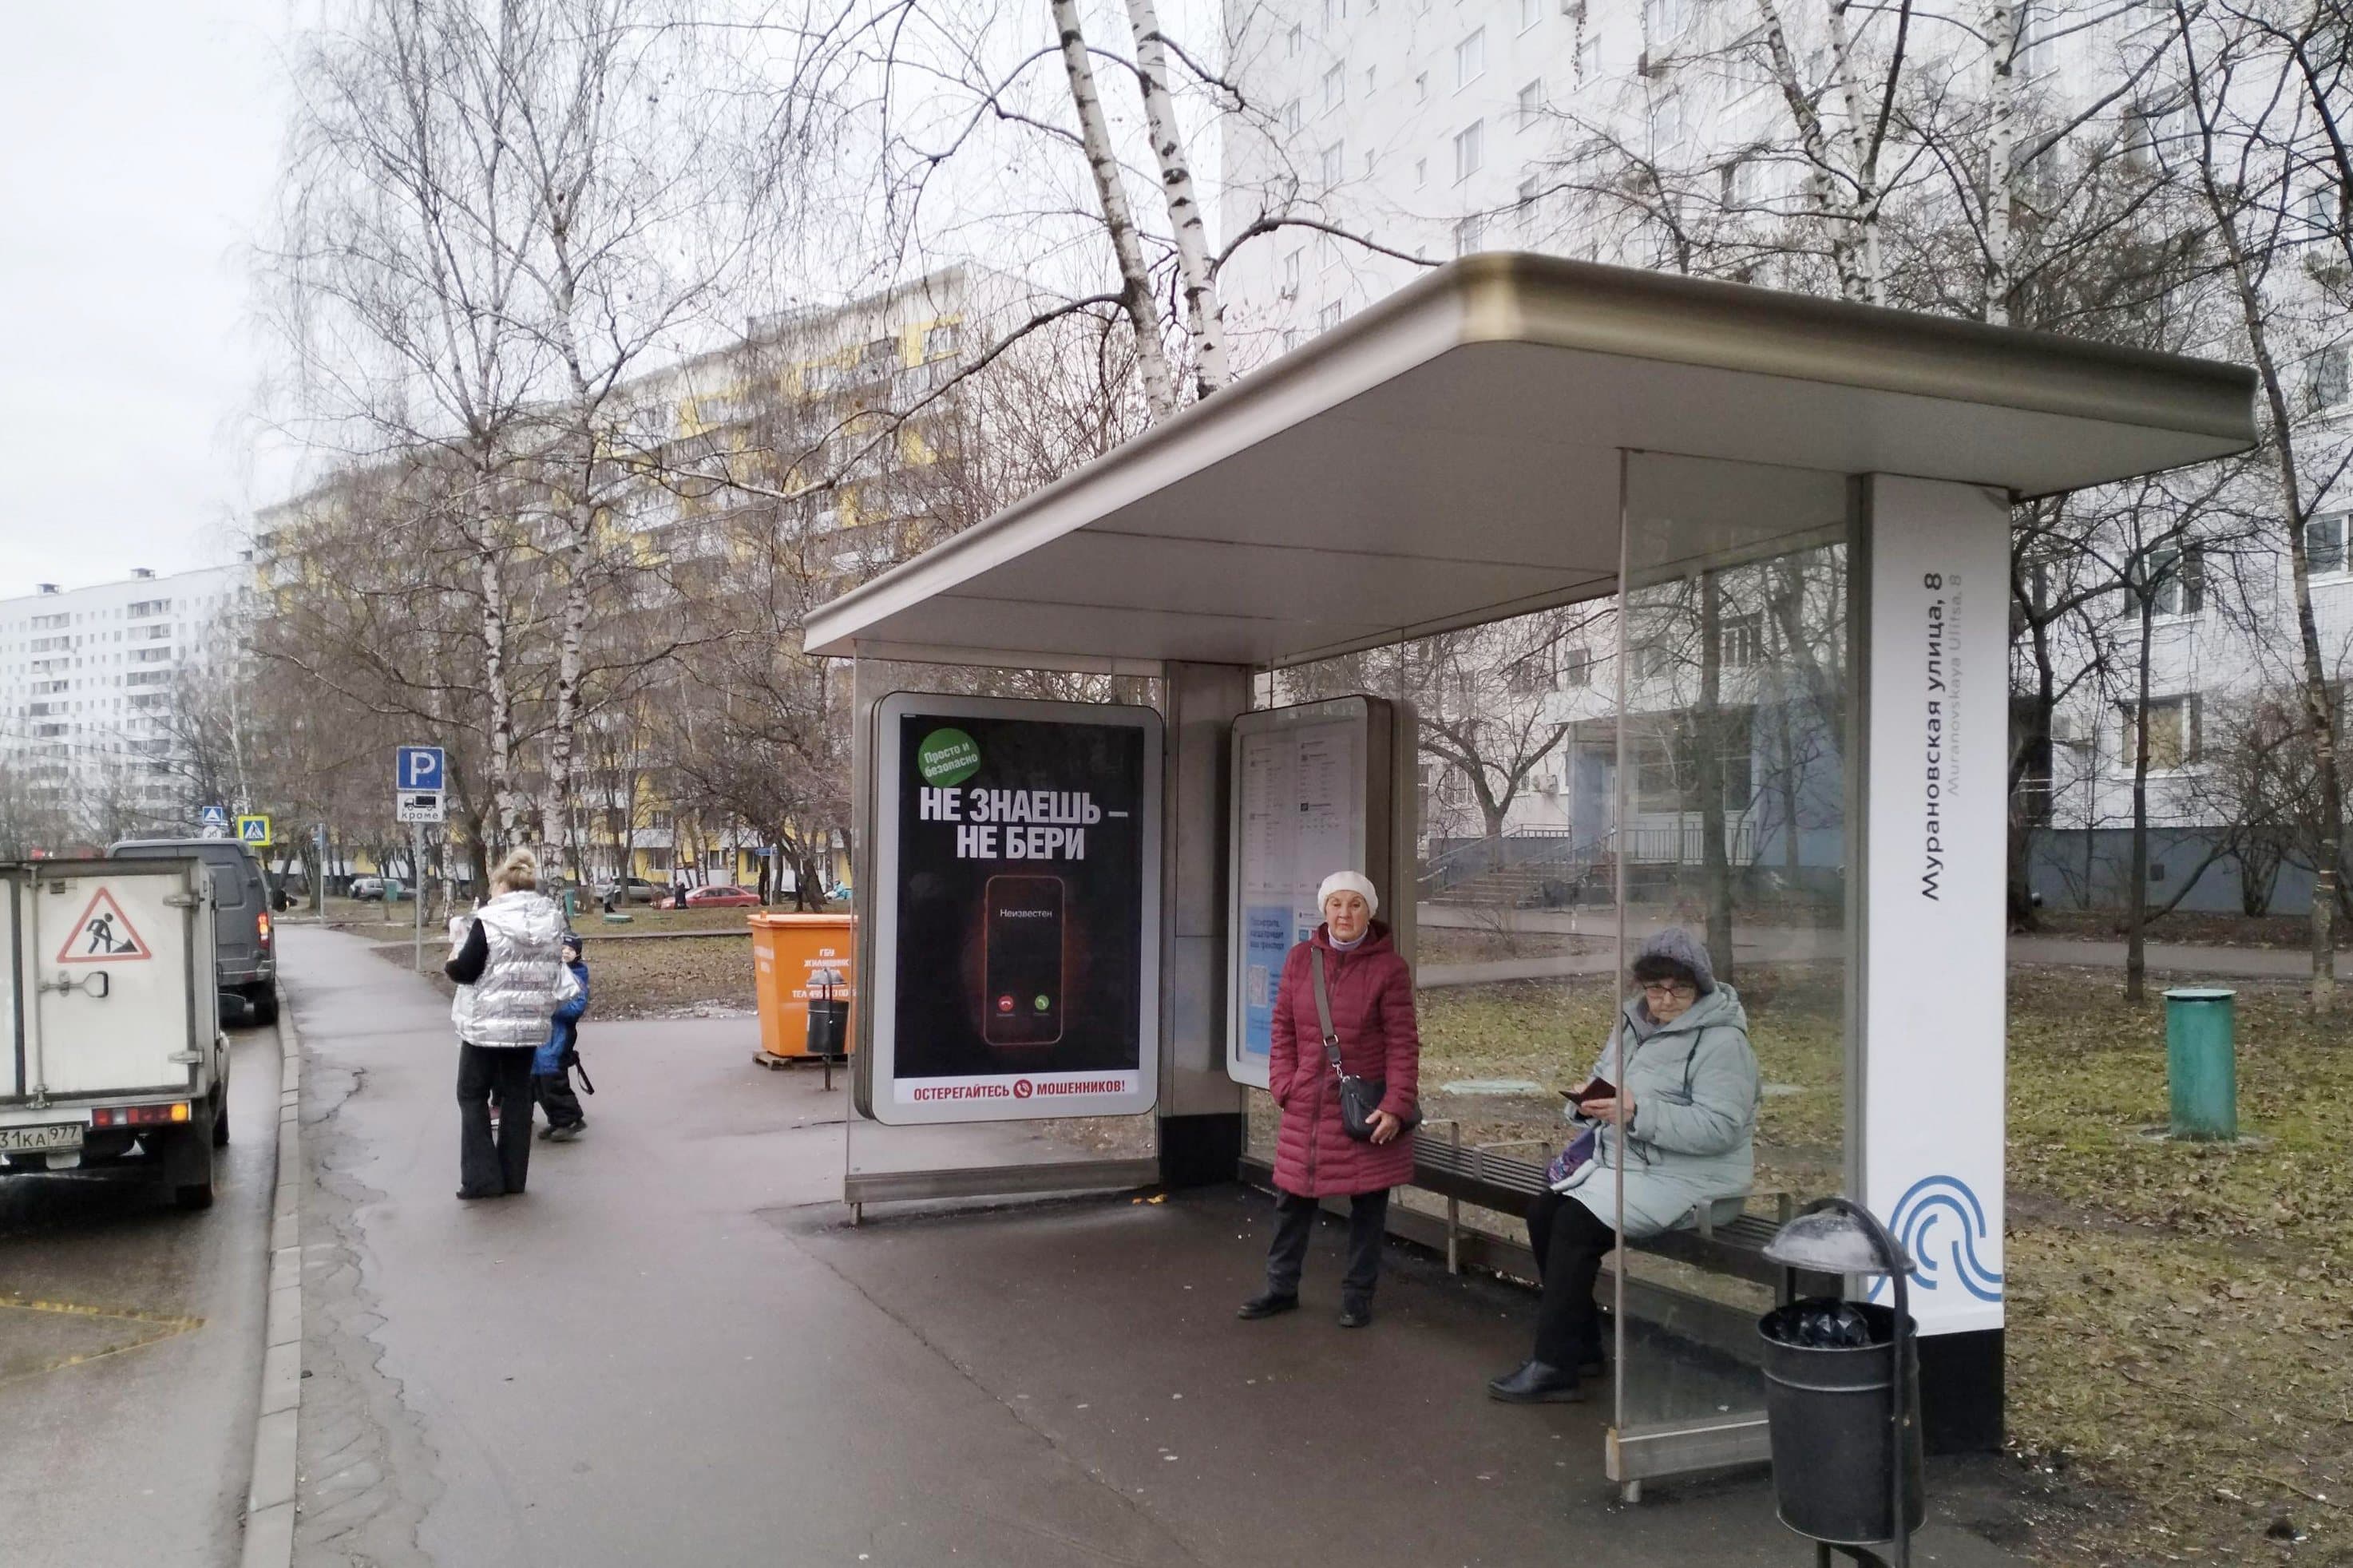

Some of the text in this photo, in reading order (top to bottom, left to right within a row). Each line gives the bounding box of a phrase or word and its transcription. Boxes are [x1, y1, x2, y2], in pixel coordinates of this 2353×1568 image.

[1948, 574, 1962, 587] 8
[1922, 573, 1946, 901] Мурановская улица, 8
[1947, 657, 1963, 797] Muranovskaya
[925, 742, 970, 764] Просто и
[410, 752, 435, 786] P
[925, 753, 978, 778] безопасно
[402, 811, 438, 822] кроме
[920, 786, 961, 821] НЕ
[969, 788, 1101, 825] ЗНАЕШЬ
[957, 825, 1084, 860] НЕ БЕРИ
[1000, 909, 1052, 918] Неизвестен
[914, 1080, 1126, 1101] ОСТЕРЕГАЙТЕСЬ МОШЕННИКОВ!
[50, 1127, 77, 1140] 977
